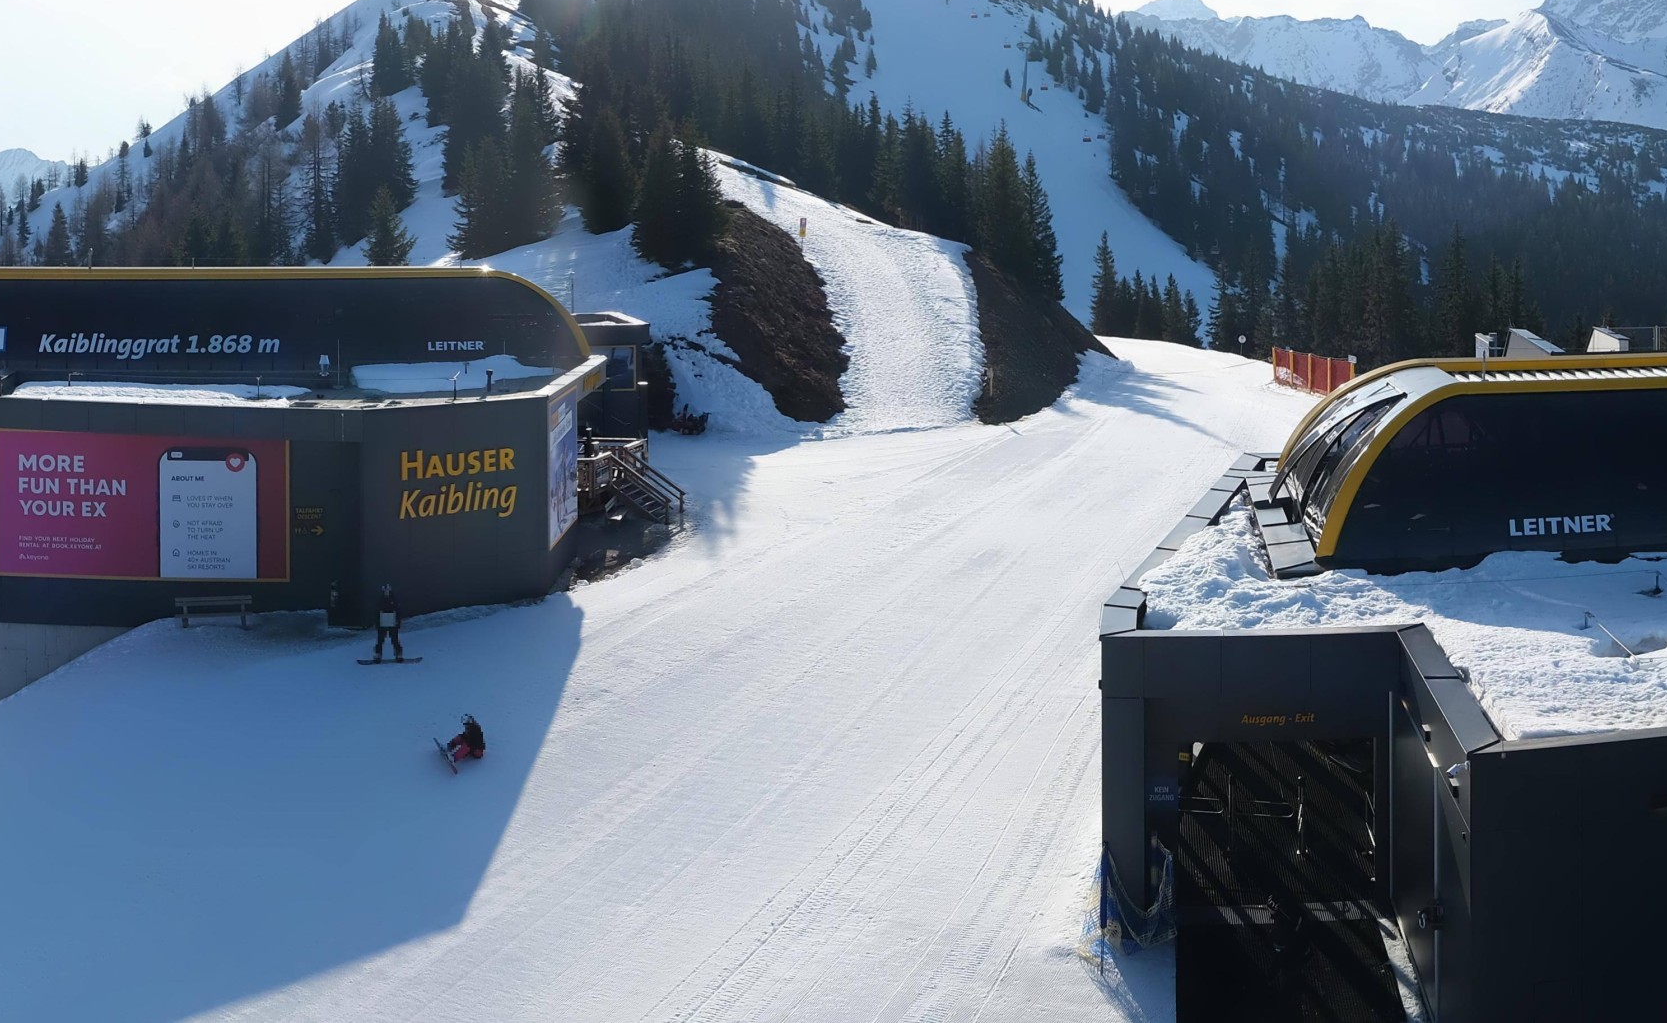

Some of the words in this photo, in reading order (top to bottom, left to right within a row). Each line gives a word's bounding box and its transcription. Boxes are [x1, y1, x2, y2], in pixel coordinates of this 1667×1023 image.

[38, 333, 180, 360] Kaiblinggrat
[185, 334, 252, 354] 1.868
[257, 337, 281, 354] m
[427, 341, 485, 351] LEITNER
[18, 454, 85, 473] MORE
[401, 448, 515, 481] HAUSER
[18, 477, 60, 494] FUN
[66, 478, 126, 496] THAN
[19, 500, 75, 516] YOUR
[81, 502, 107, 517] EX
[399, 481, 517, 519] Kaibling
[1241, 714, 1286, 726] Ausgang
[1294, 712, 1315, 723] Exit
